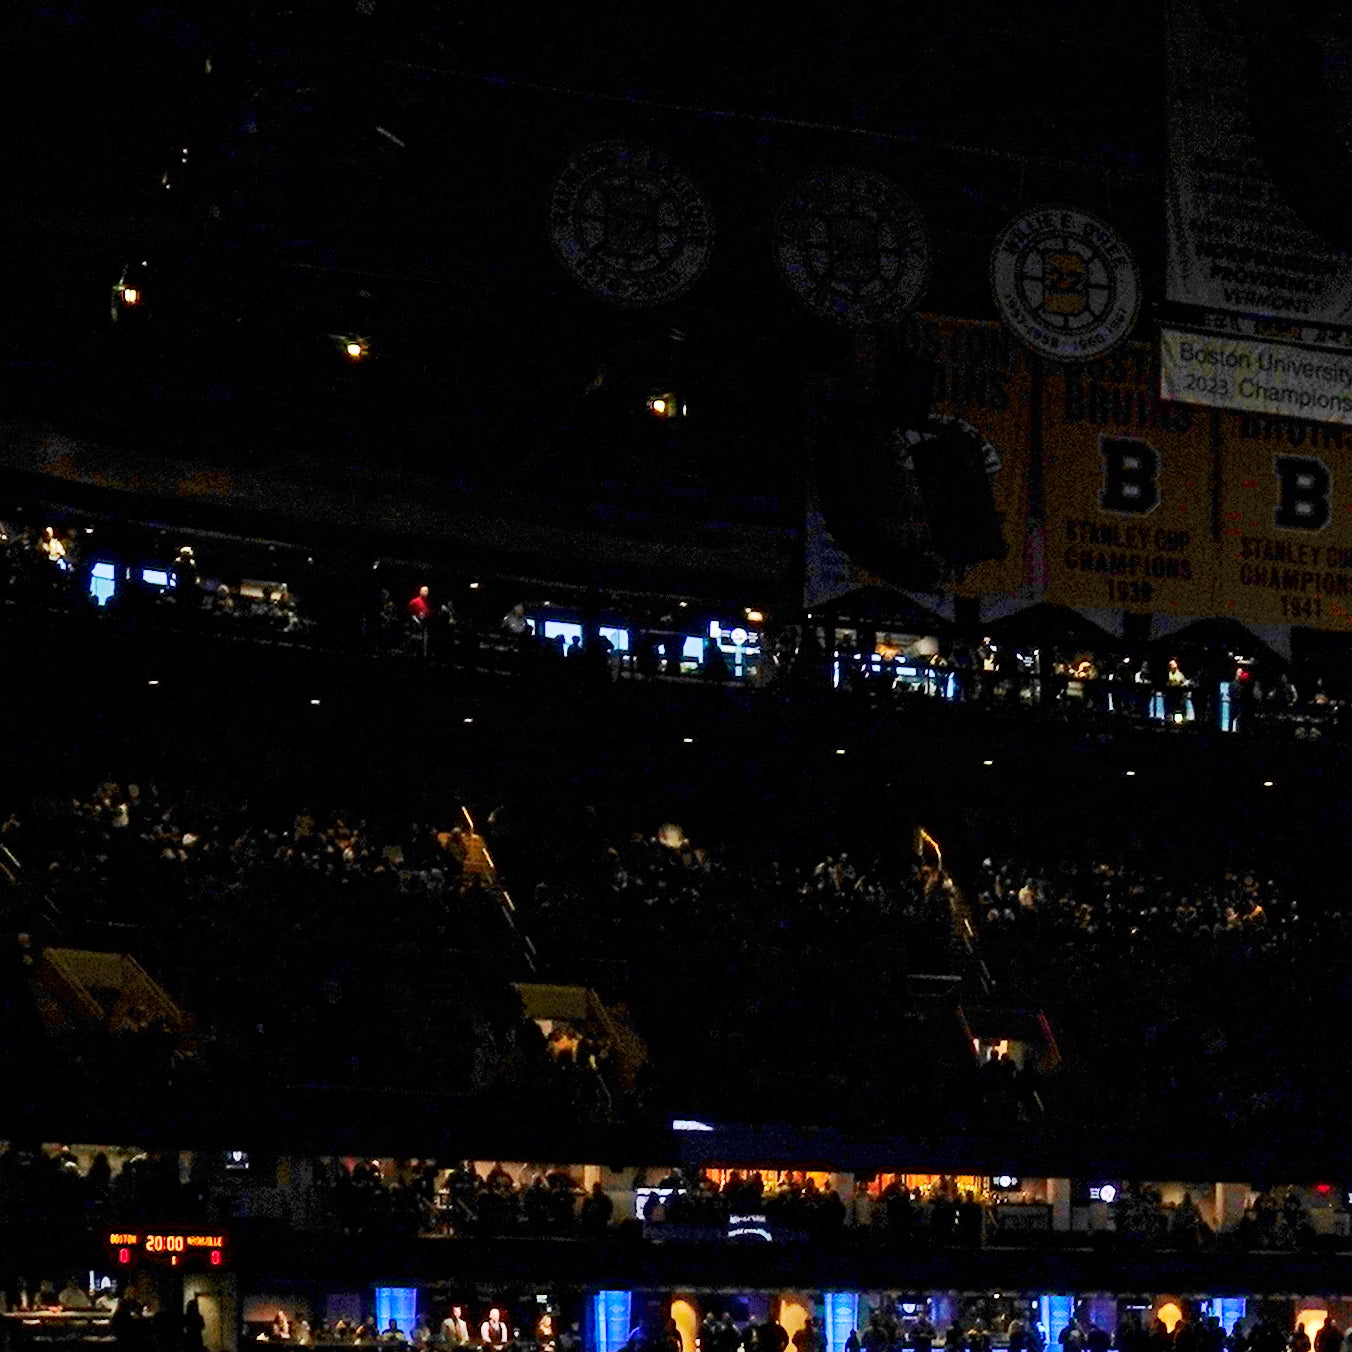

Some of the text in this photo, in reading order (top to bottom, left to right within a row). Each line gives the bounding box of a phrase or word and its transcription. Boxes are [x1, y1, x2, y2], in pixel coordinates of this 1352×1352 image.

[1180, 342, 1252, 369] Boston
[1185, 374, 1352, 413] 2023 Champions
[1066, 521, 1190, 553] STANLEY CUP
[1241, 536, 1320, 566] STANLEY
[1064, 548, 1193, 580] CHAMPIONS
[1280, 595, 1323, 619] 1941
[145, 1235, 184, 1252] 20:00
